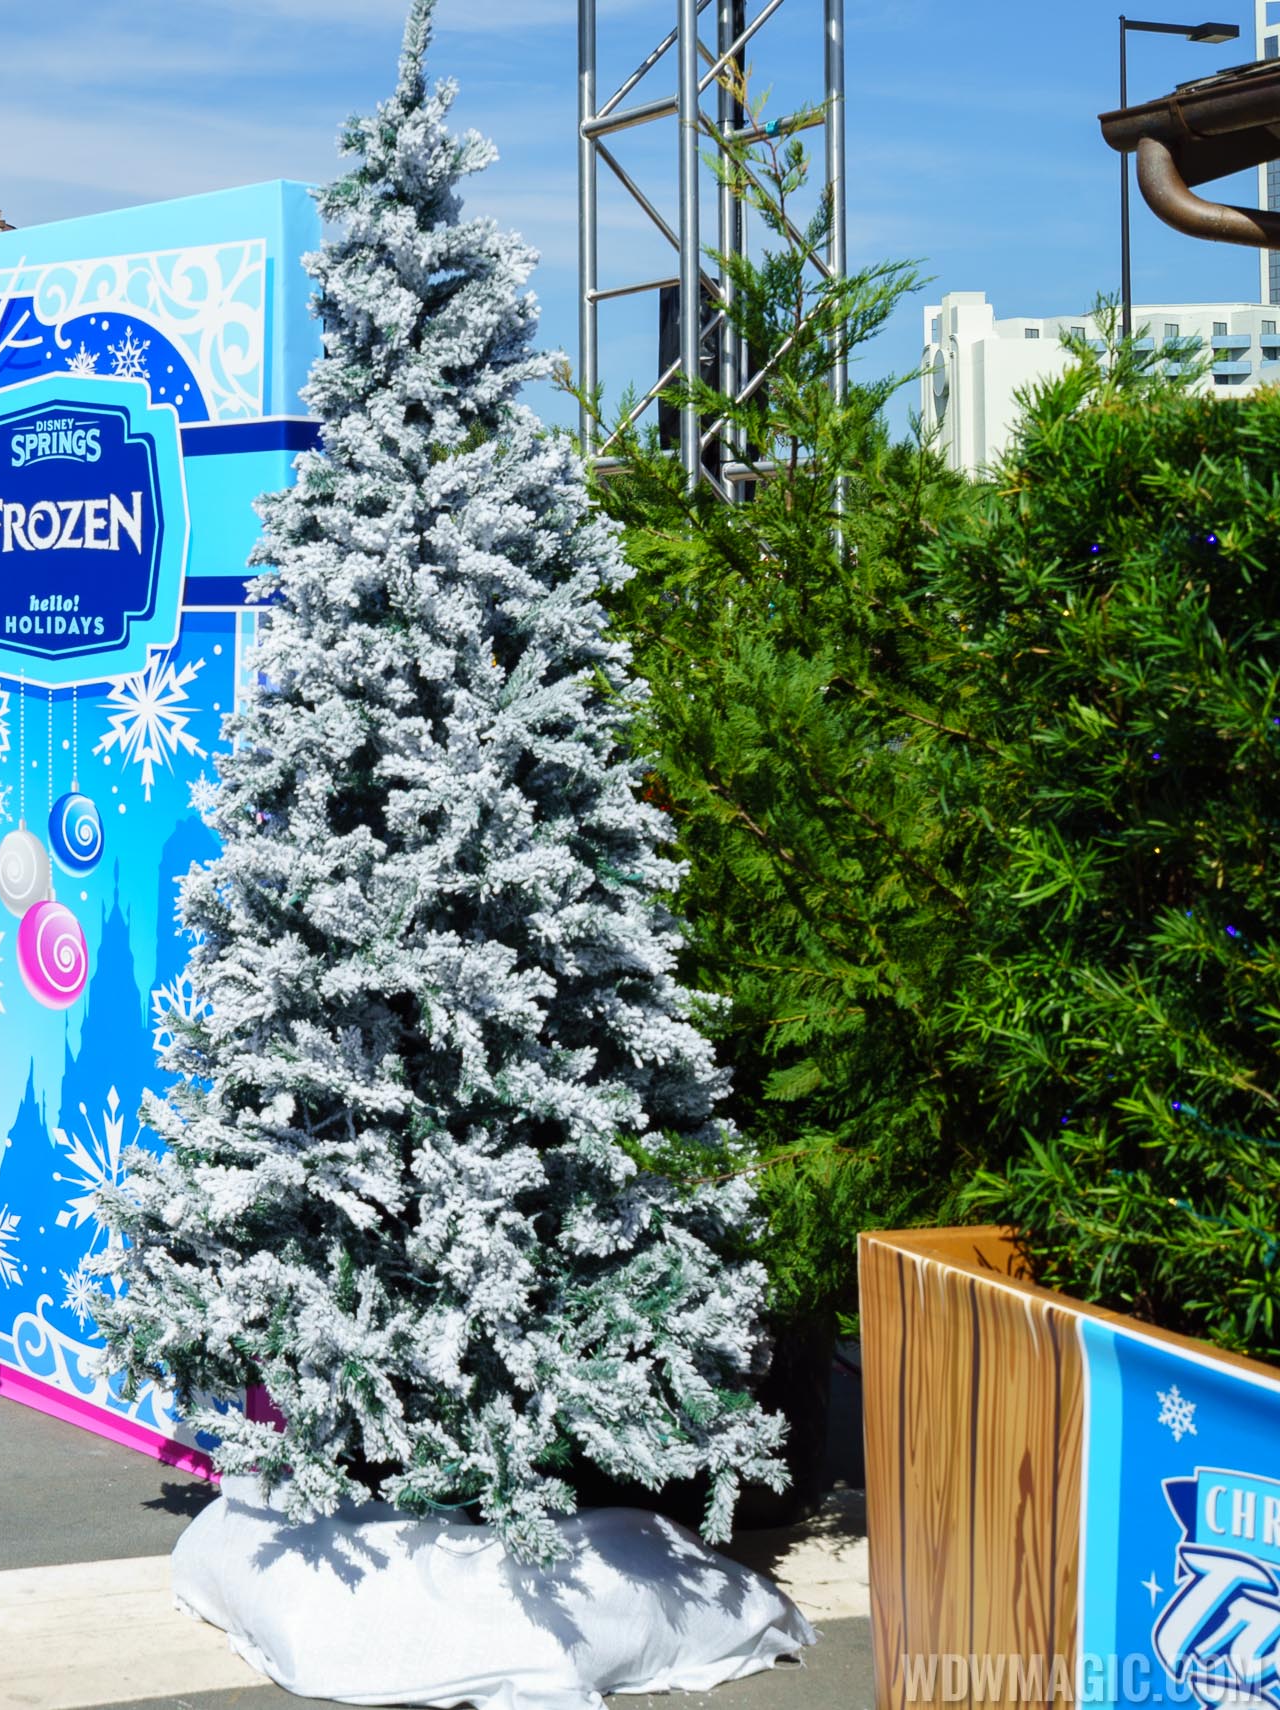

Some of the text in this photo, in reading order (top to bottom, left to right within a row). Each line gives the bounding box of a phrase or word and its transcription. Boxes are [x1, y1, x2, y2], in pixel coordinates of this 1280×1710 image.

[36, 418, 75, 431] DISNEY
[11, 428, 101, 467] SPRINGS
[29, 595, 80, 612] hello!
[5, 616, 104, 635] HOLIDAYS
